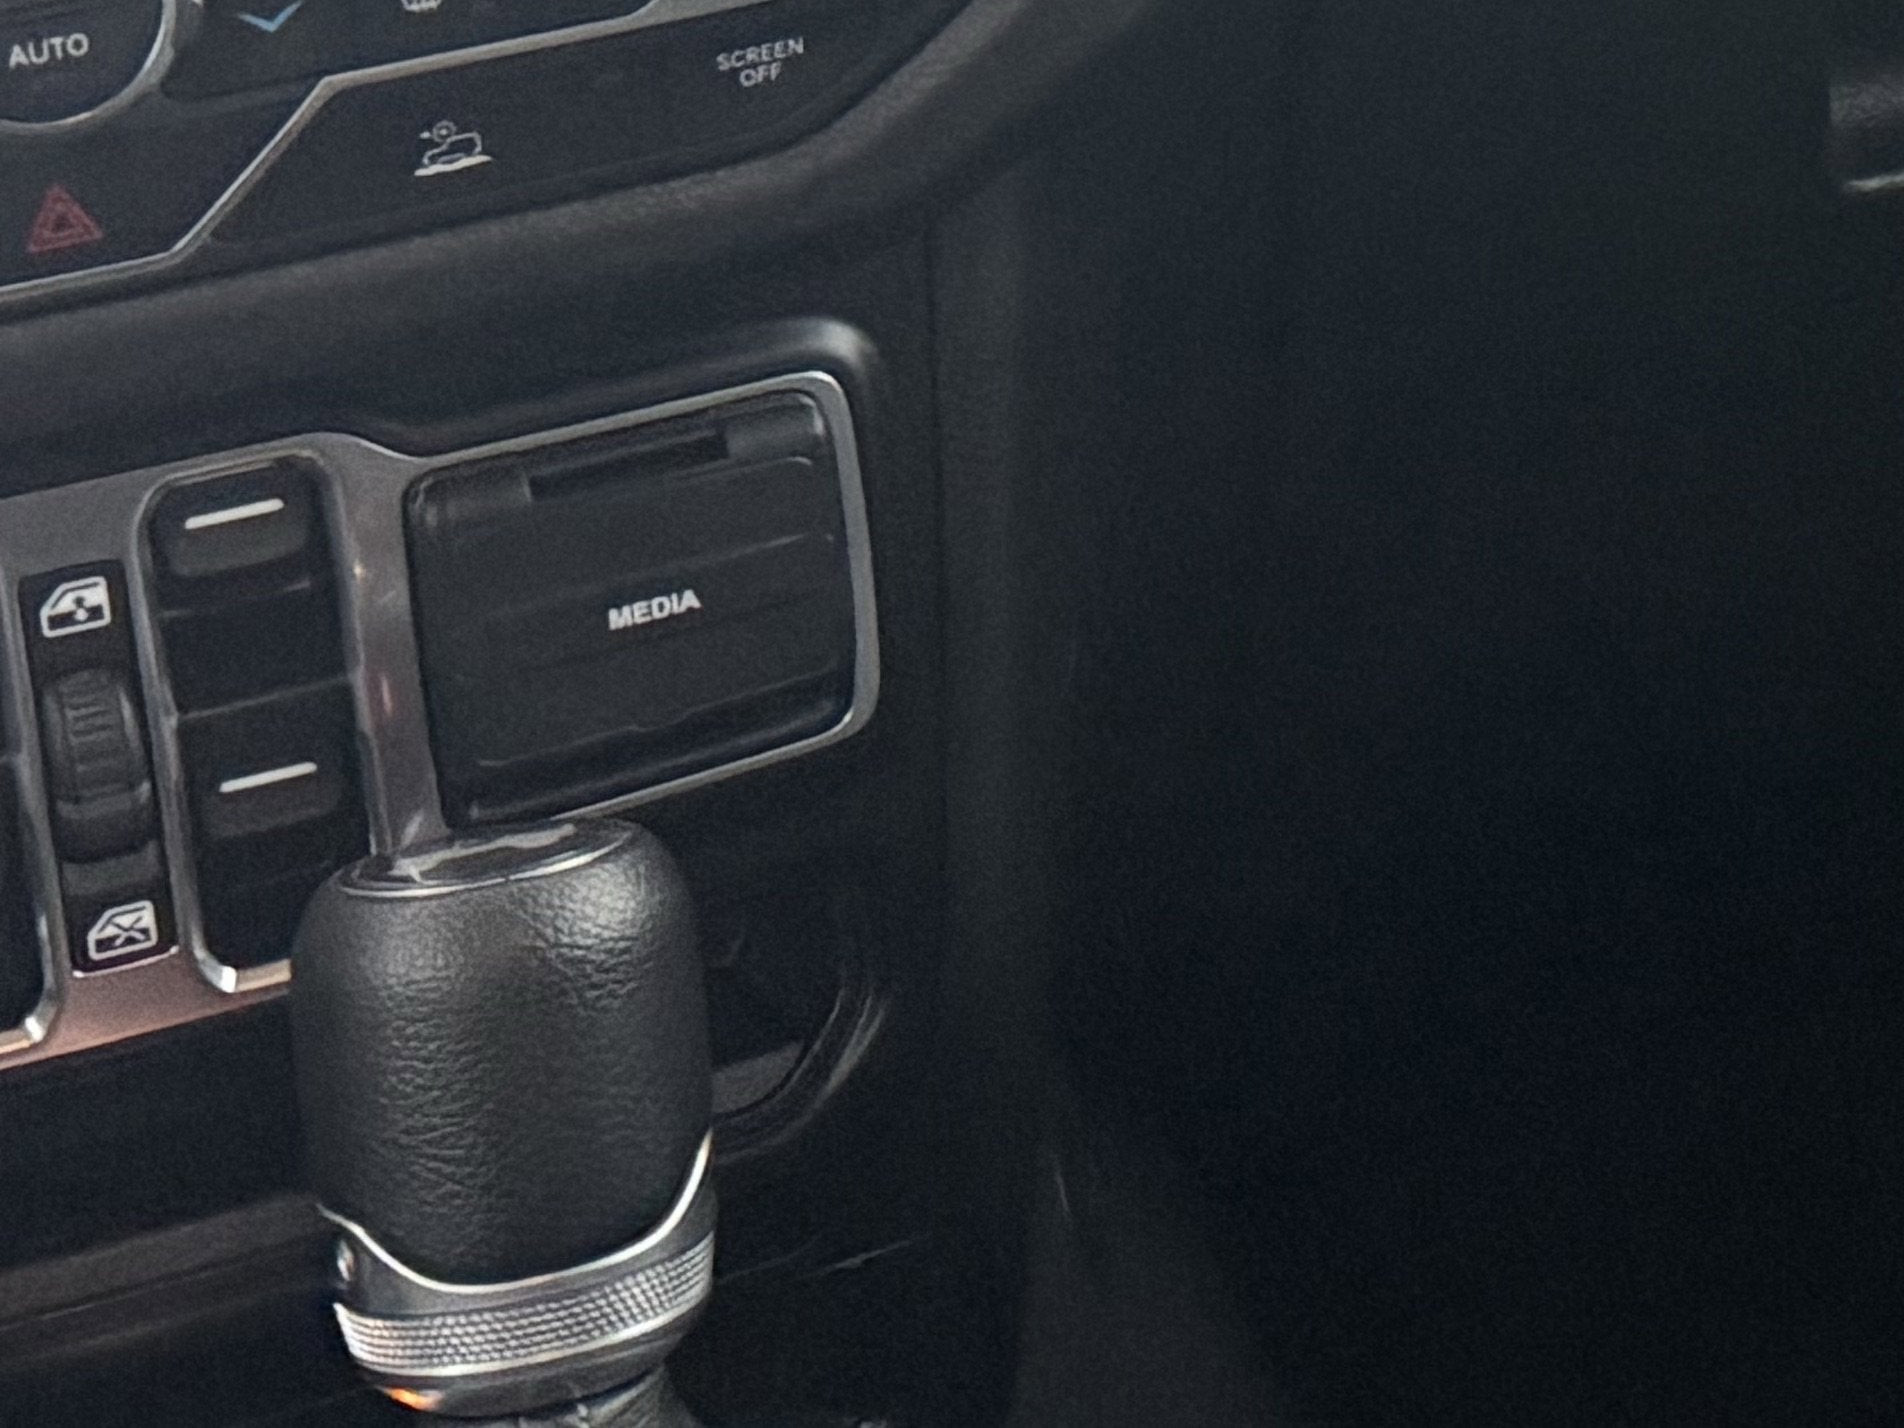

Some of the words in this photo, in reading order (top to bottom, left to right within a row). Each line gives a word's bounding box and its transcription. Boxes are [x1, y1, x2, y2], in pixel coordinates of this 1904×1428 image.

[8, 32, 91, 72] AUTO
[715, 35, 805, 72] SCREEN
[738, 59, 783, 88] OFF
[608, 588, 703, 631] MEDIA
